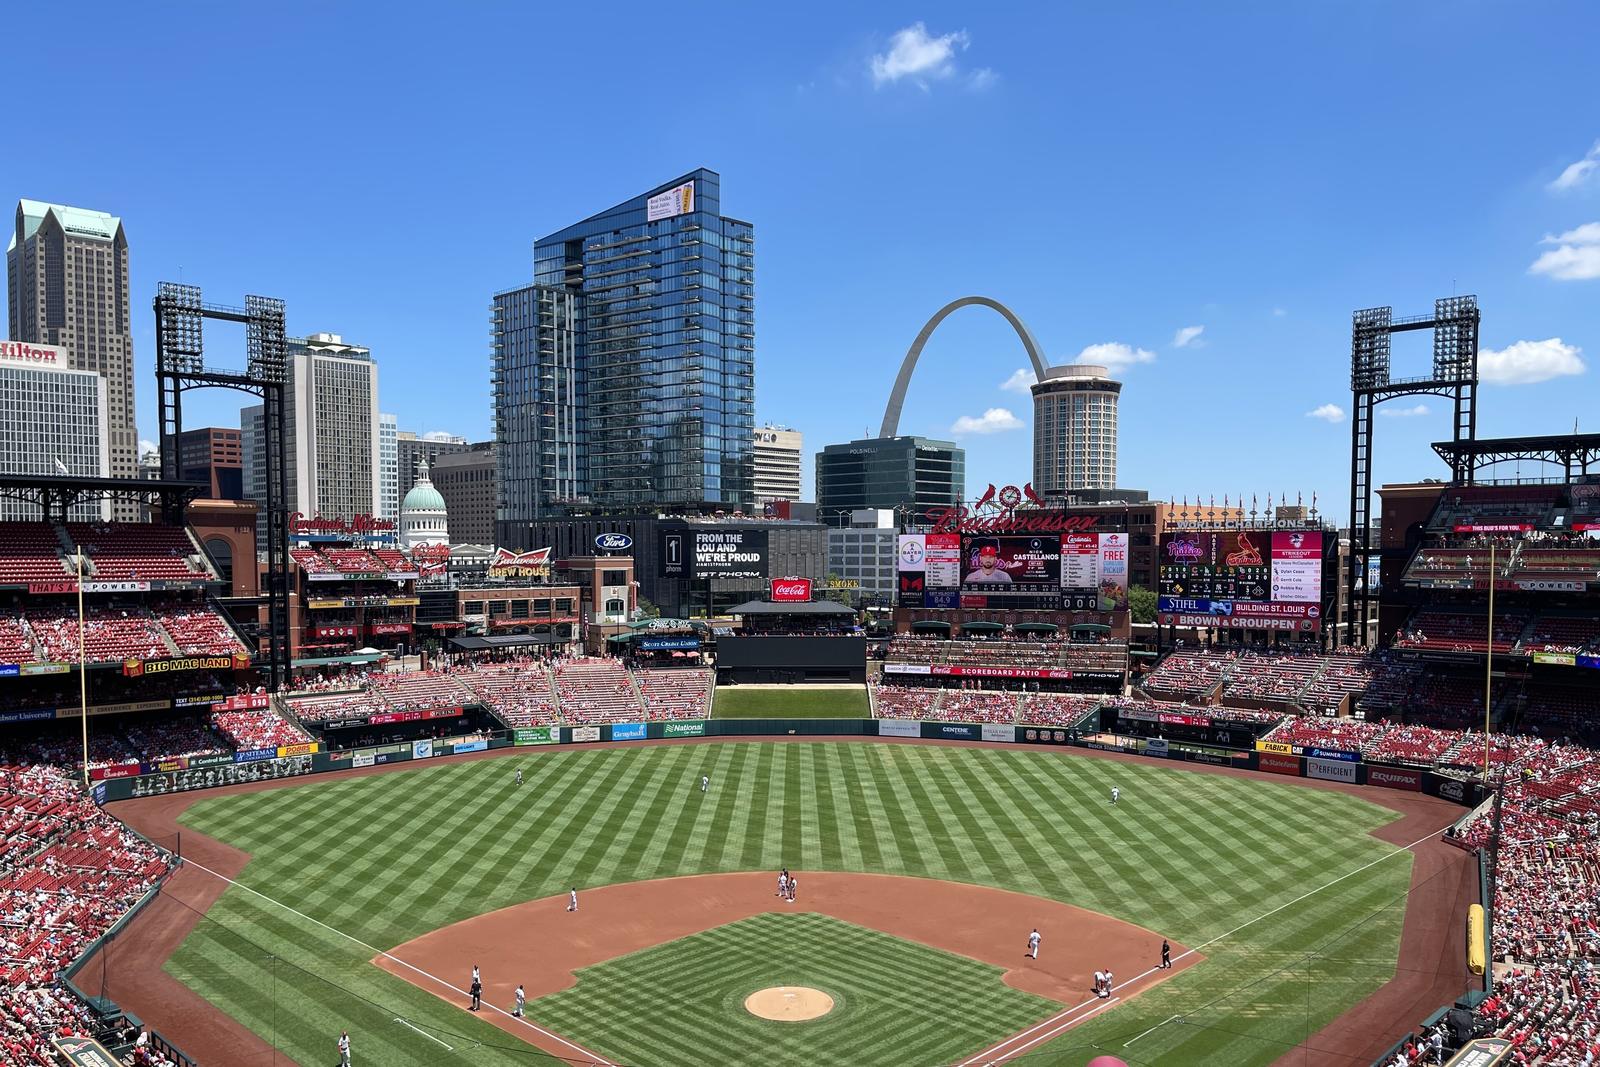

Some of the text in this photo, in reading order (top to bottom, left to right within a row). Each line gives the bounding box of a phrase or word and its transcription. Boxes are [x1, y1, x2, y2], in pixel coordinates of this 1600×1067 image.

[289, 511, 397, 534] Cardinals Nation
[926, 506, 1099, 534] Budweiser
[1177, 519, 1306, 529] WORLD CHAMPIONS
[336, 534, 366, 542] ROOFTOP
[603, 534, 626, 548] Ford
[696, 533, 743, 543] FROM THE
[1067, 535, 1092, 544] Cardinals
[696, 543, 737, 553] LOU AND
[1167, 541, 1203, 557] Phillies
[490, 552, 545, 567] Budweiser
[696, 553, 760, 563] WE'RE PROUD
[1103, 550, 1125, 560] FREE
[488, 566, 550, 577] BREW HOUSE
[31, 583, 73, 592] THAT'S A
[92, 582, 136, 590] POWER
[829, 579, 859, 588] SMOKE
[1475, 581, 1506, 589] THA'S
[775, 584, 806, 596] Coca-Cola
[934, 596, 951, 604] 84.9
[1064, 598, 1096, 608] 0 0 0
[1169, 597, 1199, 609] STIFEL
[1235, 603, 1270, 613] BUILDING
[1271, 604, 1283, 613] ST.
[1283, 605, 1306, 614] LOUIS
[1179, 615, 1295, 629] BROWN & CROUPPEN
[144, 657, 231, 674] BIG MAC LAND
[961, 667, 1014, 677] SCOREBOARD
[1015, 670, 1040, 678] PATIO
[19, 711, 52, 721] University
[673, 722, 703, 733] National
[246, 748, 275, 758] SITEMAN
[286, 744, 310, 753] DOBBS
[1264, 743, 1304, 755] FABICK CAT
[198, 755, 234, 765] Central Bank
[1308, 762, 1354, 778] PERFICIENT
[1371, 770, 1417, 785] EQUIFAX
